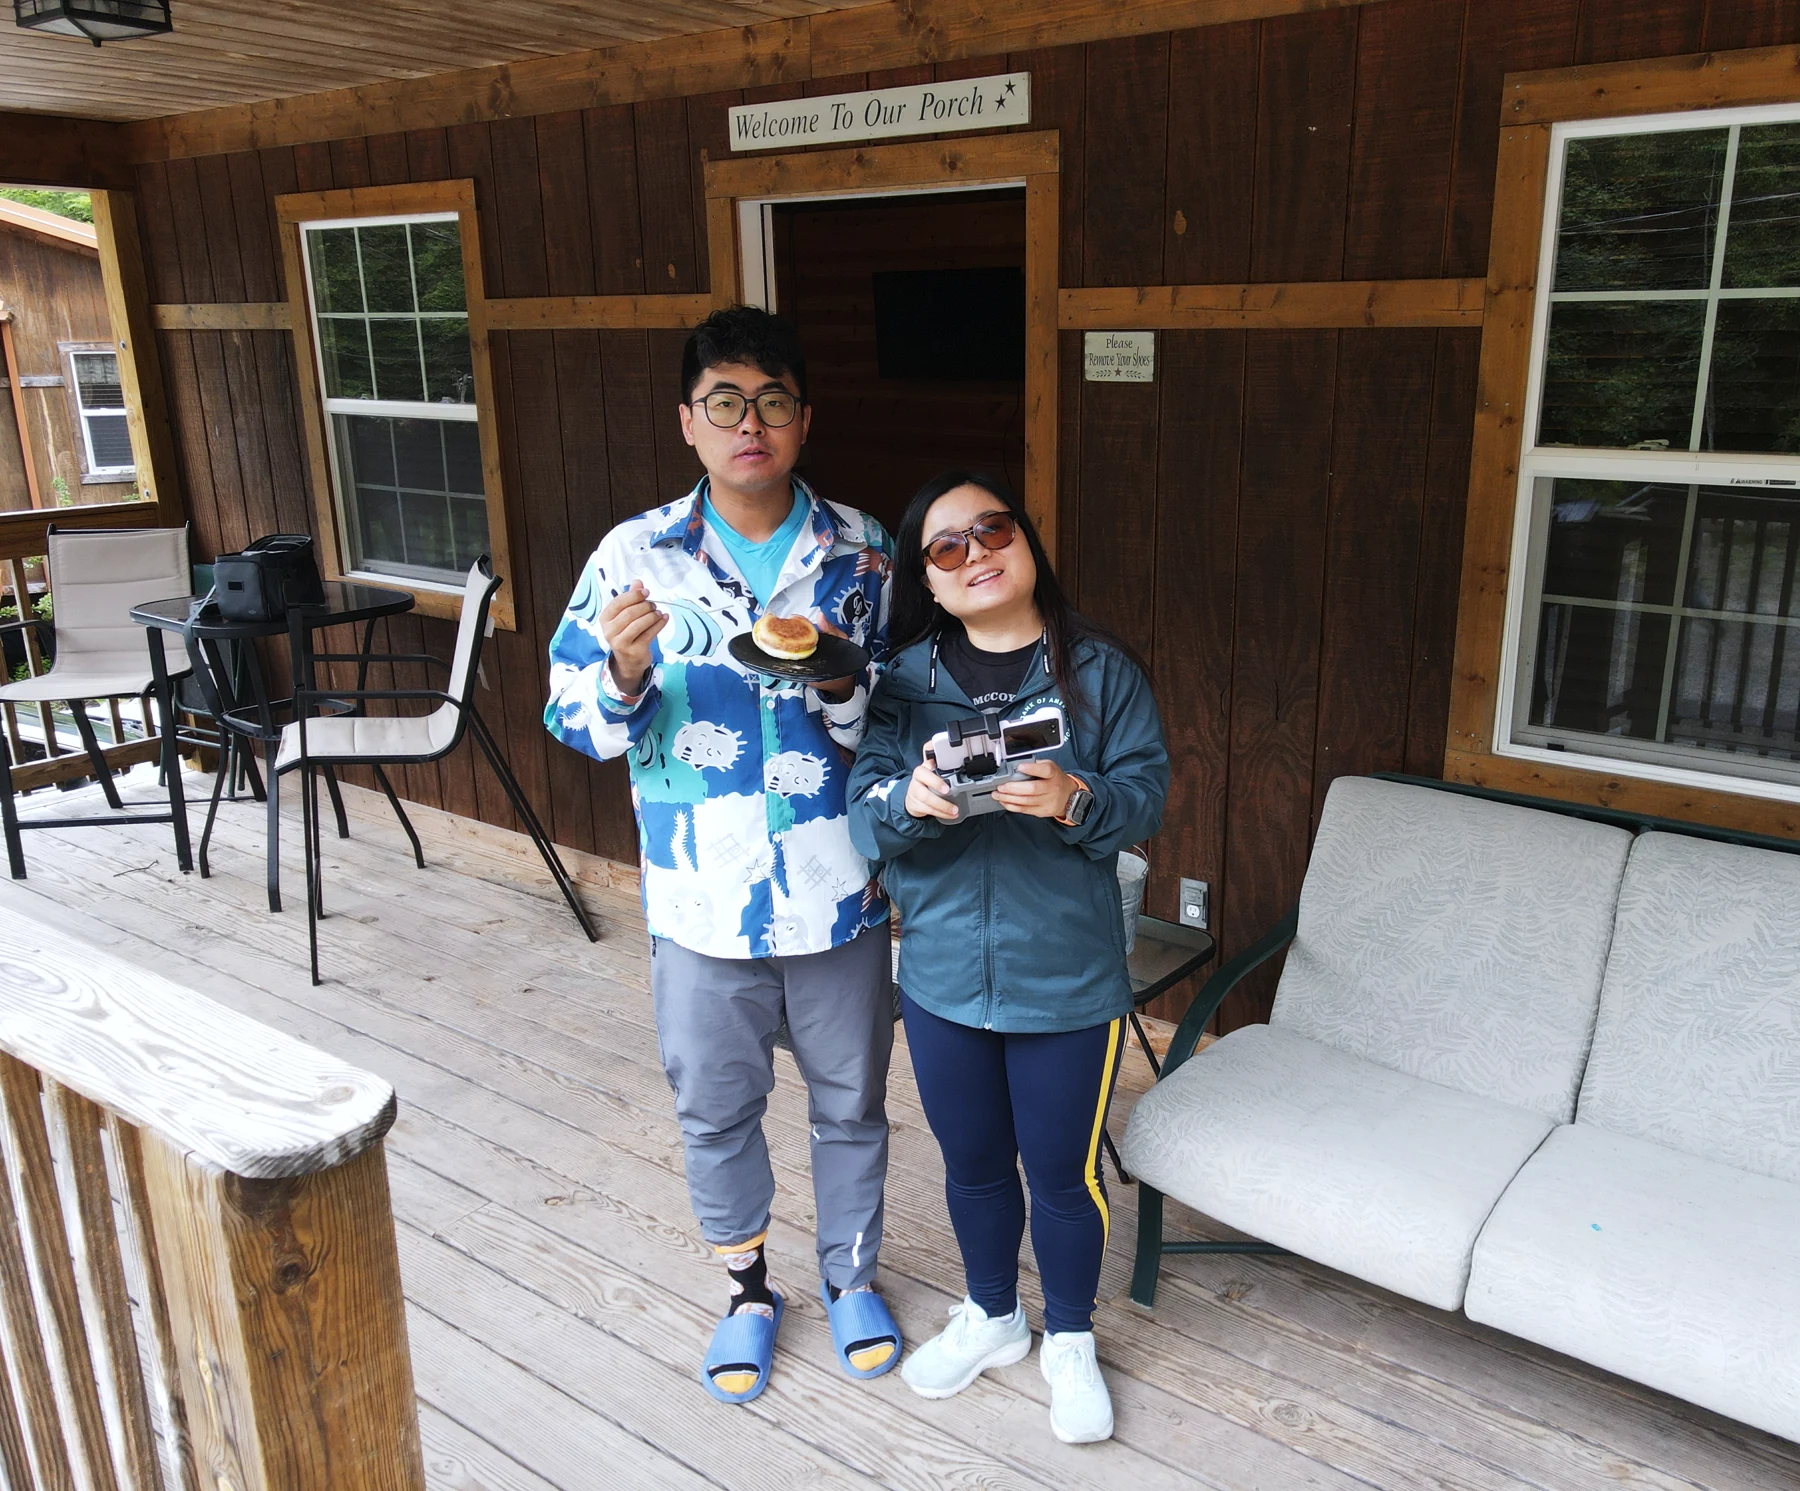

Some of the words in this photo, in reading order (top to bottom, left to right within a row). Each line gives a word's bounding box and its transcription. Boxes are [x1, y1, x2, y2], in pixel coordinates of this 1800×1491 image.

[736, 112, 819, 140] Welcome
[831, 103, 853, 130] To
[864, 98, 907, 127] Our
[918, 86, 984, 122] Porch
[1105, 334, 1133, 348] Please
[1088, 353, 1115, 367] Remove
[1116, 353, 1132, 367] Your
[1132, 346, 1150, 369] Shoes
[972, 691, 1017, 706] MCCOY
